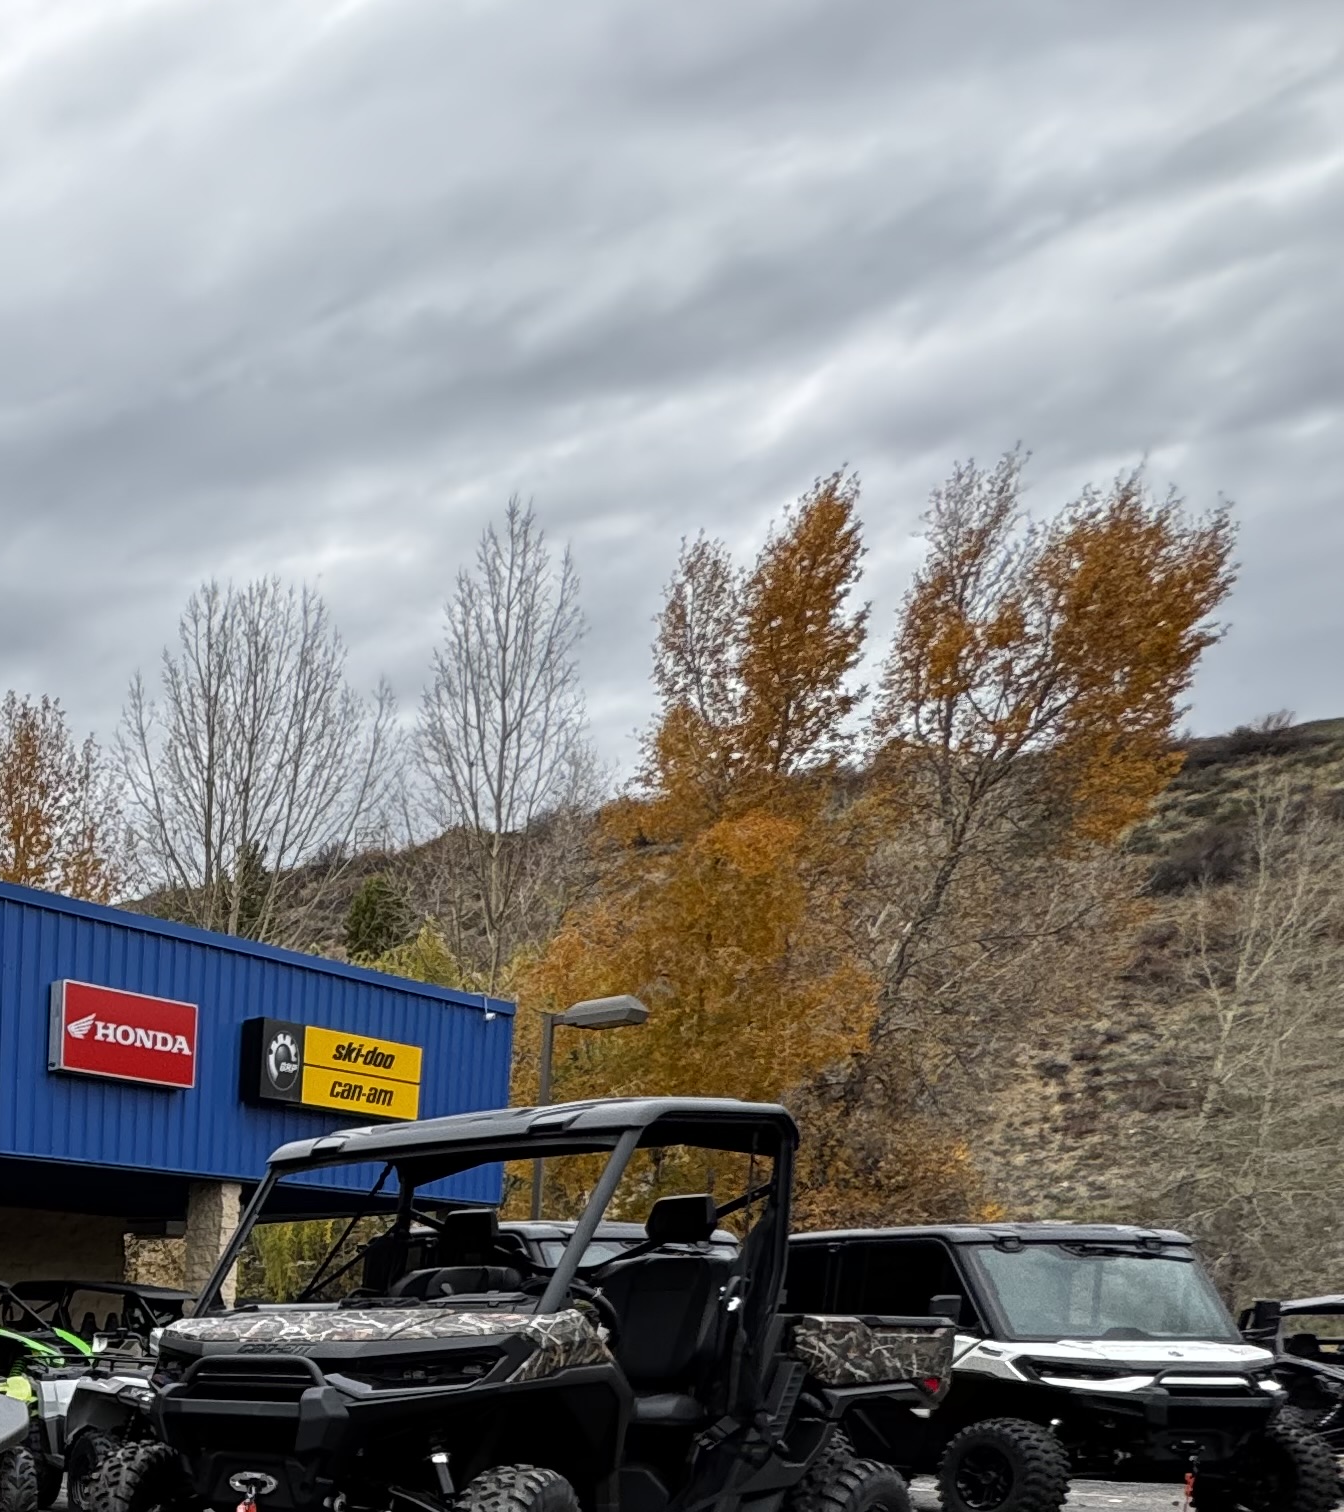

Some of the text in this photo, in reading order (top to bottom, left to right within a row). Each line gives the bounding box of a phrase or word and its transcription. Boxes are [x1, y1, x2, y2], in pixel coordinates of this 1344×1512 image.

[94, 1019, 192, 1056] HONDA
[332, 1042, 396, 1070] ski-doo
[329, 1079, 394, 1107] can-am
